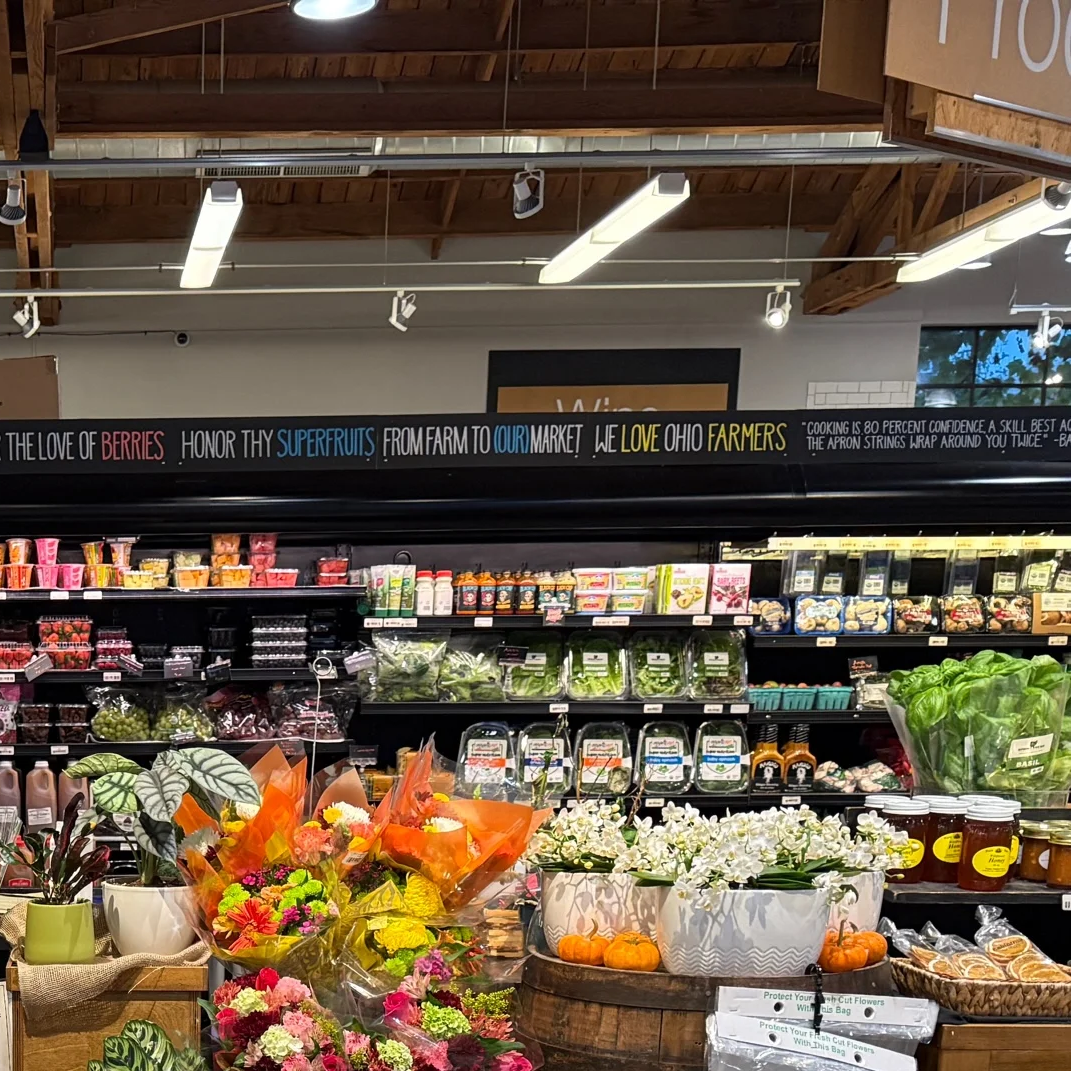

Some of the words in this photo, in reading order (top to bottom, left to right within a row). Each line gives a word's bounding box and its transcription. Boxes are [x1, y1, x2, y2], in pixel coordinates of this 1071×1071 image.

[863, 420, 879, 435] 80
[883, 420, 927, 435] PERCENT
[929, 419, 987, 435] CONFIDENCE,
[988, 420, 996, 433] A
[1000, 419, 1027, 433] SKILL
[1031, 418, 1057, 433] BEST
[5, 432, 34, 461] THE
[37, 431, 75, 461] LOVE
[78, 431, 98, 461] OF
[101, 431, 165, 461] BERRIES
[181, 430, 235, 460] HONOR
[241, 429, 274, 459] THY
[276, 427, 375, 459] SUPERFRUITS
[383, 426, 424, 456] FROM
[426, 426, 469, 456] FARM
[471, 425, 491, 455] TO
[493, 424, 530, 455] (OUR)
[531, 423, 584, 455] MARKET
[594, 424, 618, 454] WE
[620, 423, 660, 453] LOVE
[664, 422, 703, 452] OHIO
[707, 422, 787, 453] FARMERS
[806, 436, 825, 450] THE
[827, 435, 861, 450] APRON
[863, 435, 906, 449] STRINGS
[909, 434, 937, 449] WRAP
[941, 434, 982, 449] AROUND
[985, 434, 1007, 448] YOU
[1016, 760, 1040, 768] BASIL
[763, 992, 794, 1002] Protect
[795, 993, 813, 1002] Your
[838, 996, 853, 1004] Cut
[854, 998, 885, 1007] Flowers
[797, 1003, 815, 1012] With
[819, 1005, 833, 1014] his
[835, 1006, 852, 1016] Bag
[759, 1022, 789, 1034] Protect
[789, 1027, 808, 1038] Your
[809, 1031, 831, 1043] Fresh
[832, 1037, 846, 1047] Cut
[847, 1039, 875, 1055] Flowers
[793, 1037, 811, 1048] With
[811, 1040, 830, 1052] This
[831, 1044, 846, 1057] Bag
